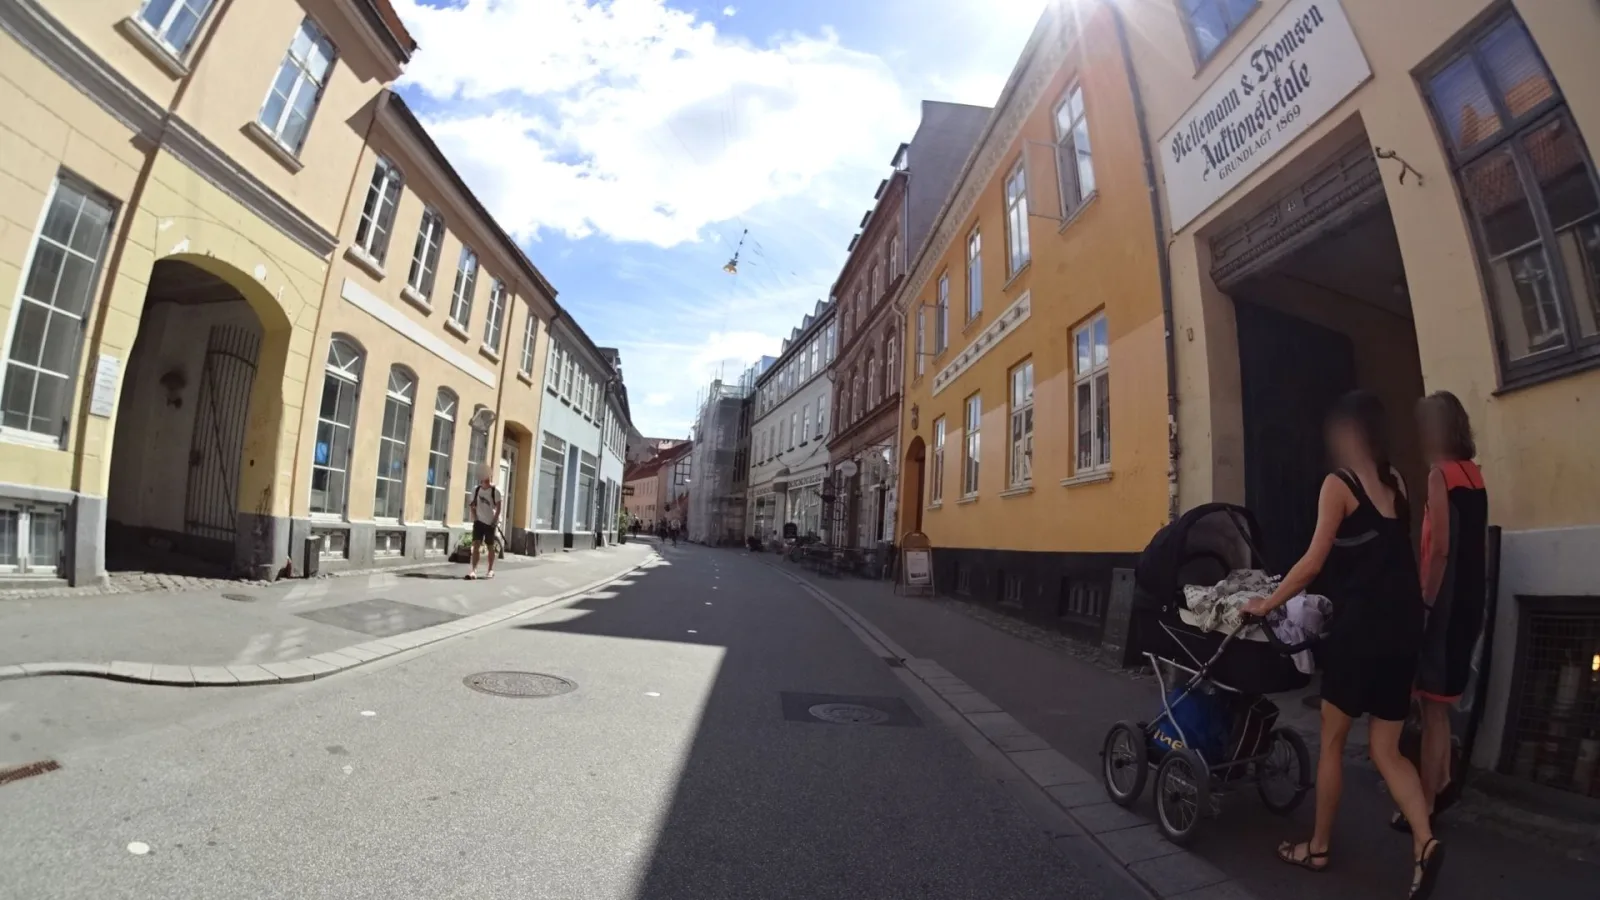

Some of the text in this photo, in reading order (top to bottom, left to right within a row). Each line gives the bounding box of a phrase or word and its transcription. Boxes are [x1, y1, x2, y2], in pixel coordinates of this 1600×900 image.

[1172, 5, 1324, 163] Nellemann & Thomsen
[1201, 60, 1312, 182] Auktionslokale
[1219, 104, 1301, 180] GRUNDLAGT 1869
